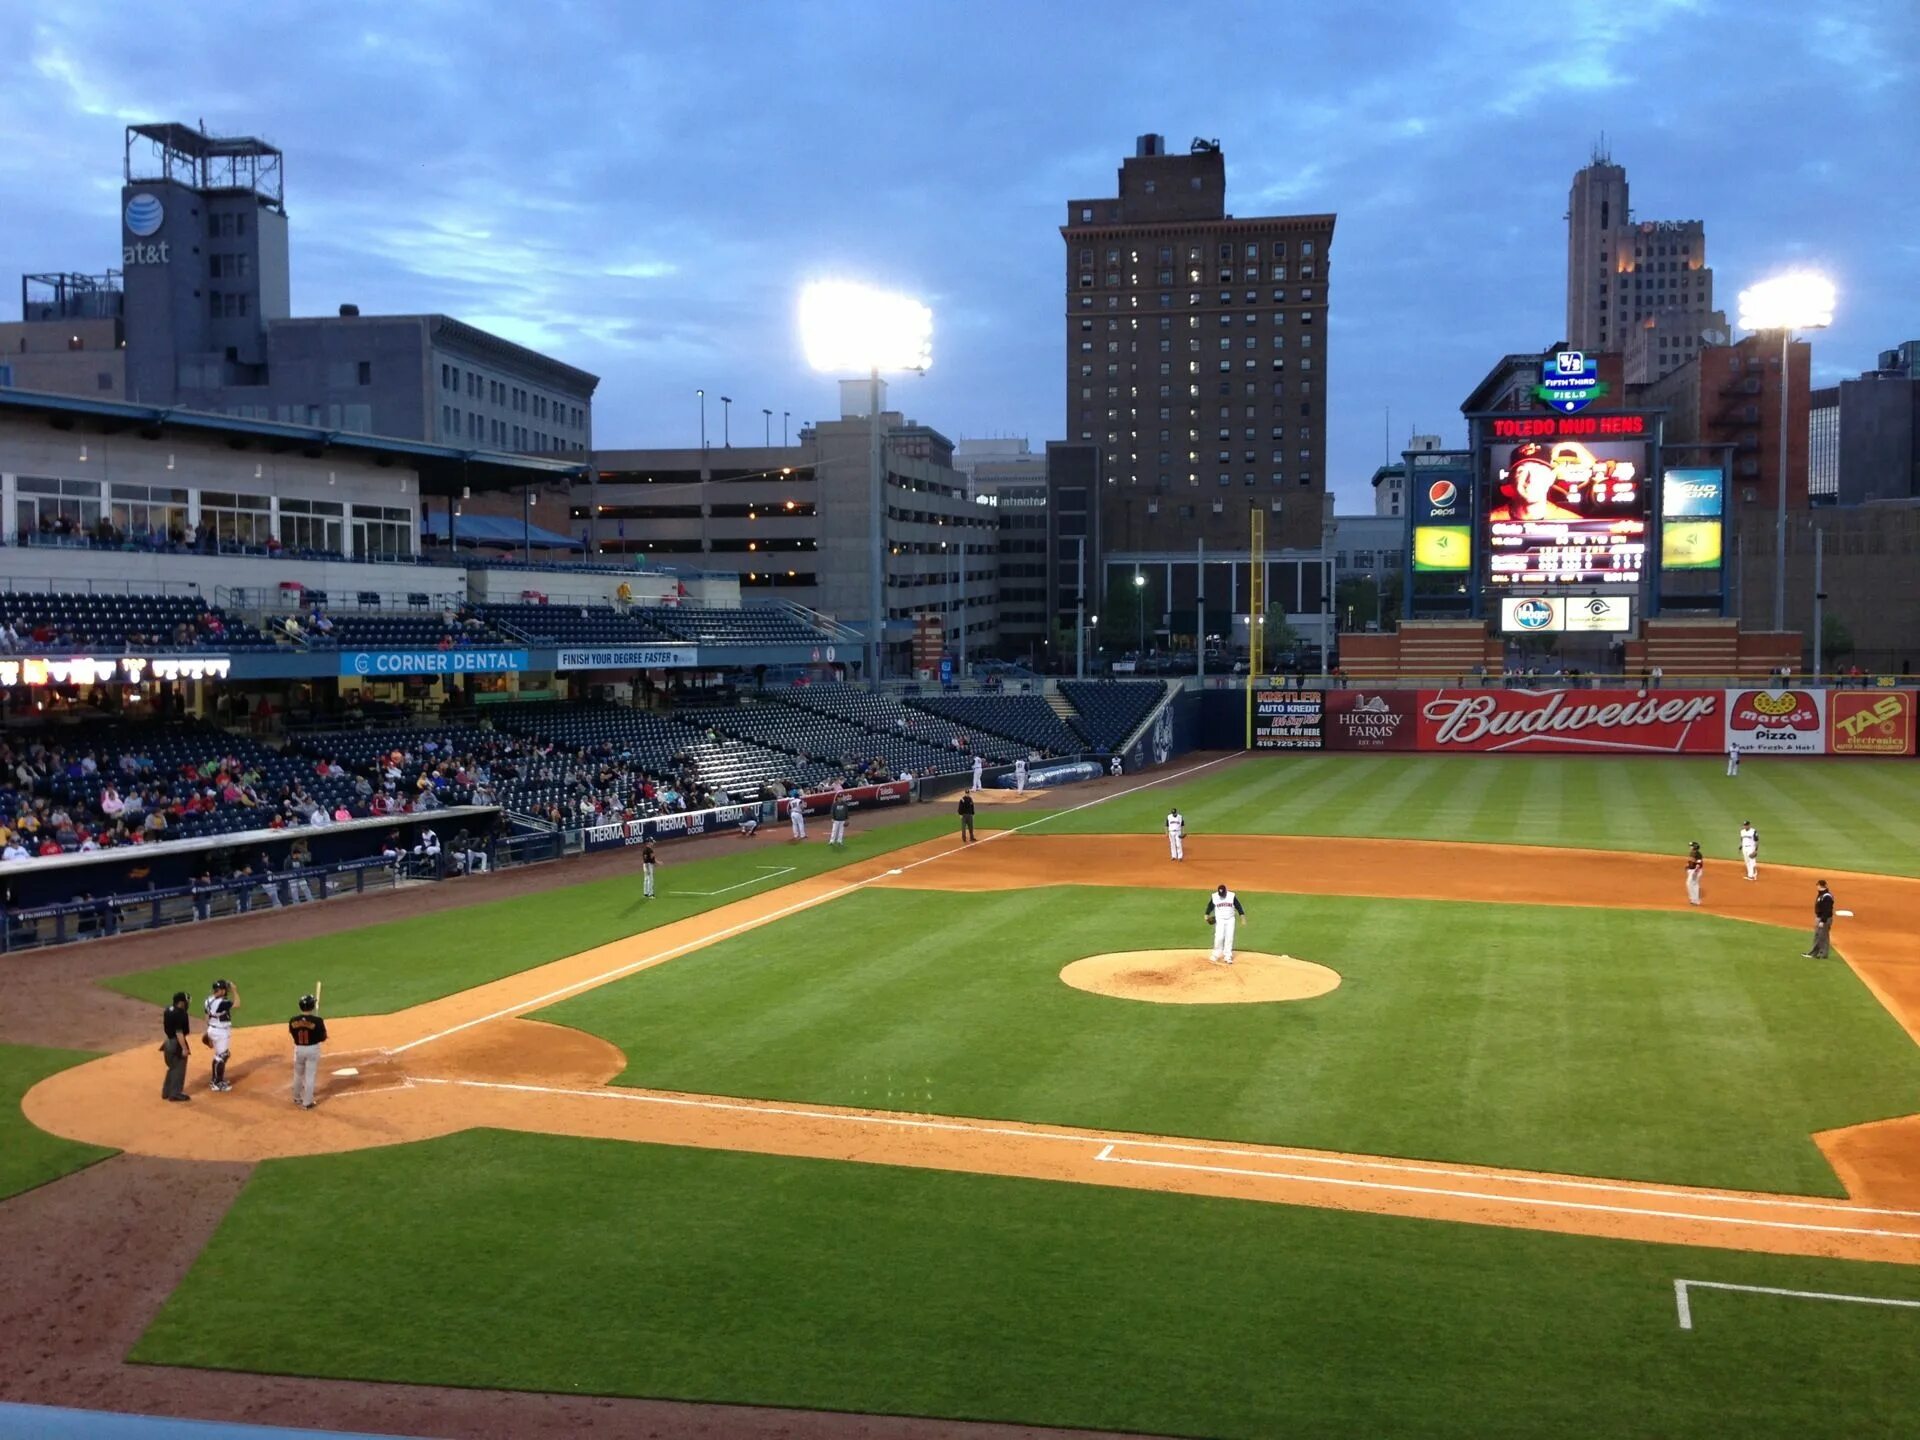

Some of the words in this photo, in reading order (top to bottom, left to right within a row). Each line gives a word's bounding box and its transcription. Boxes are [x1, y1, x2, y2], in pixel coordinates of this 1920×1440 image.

[124, 241, 170, 265] at&t
[1554, 391, 1587, 399] FIELD
[1494, 418, 1555, 437] TOLEDO
[1559, 417, 1597, 435] MUD
[1600, 416, 1643, 434] HENS
[1431, 507, 1455, 517] pepsi
[376, 653, 448, 672] CORNER
[454, 652, 518, 670] DENTAL
[562, 653, 590, 665] FINISH
[592, 653, 611, 664] YOUR
[613, 652, 642, 664] DEGREE
[644, 651, 671, 664] FASTER
[1270, 677, 1286, 686] 320
[1256, 691, 1321, 703] KISTLER
[1258, 704, 1285, 713] AUTO
[1286, 704, 1321, 713] KREDIT
[1339, 713, 1403, 725] HICKORY
[1422, 689, 1717, 745] Budweiser
[1836, 695, 1903, 737] TAS
[1256, 727, 1271, 736] BUY
[1290, 727, 1302, 737] PAY
[1303, 727, 1321, 736] HERE
[1348, 726, 1394, 739] FARMS
[1847, 734, 1904, 745] electronics
[716, 807, 744, 823] THERMA
[656, 817, 687, 833] THERMA
[692, 813, 705, 827] TRU
[589, 827, 625, 844] THERMA
[629, 823, 644, 837] TRU
[687, 826, 704, 836] DOORS
[625, 836, 643, 846] DOORS
